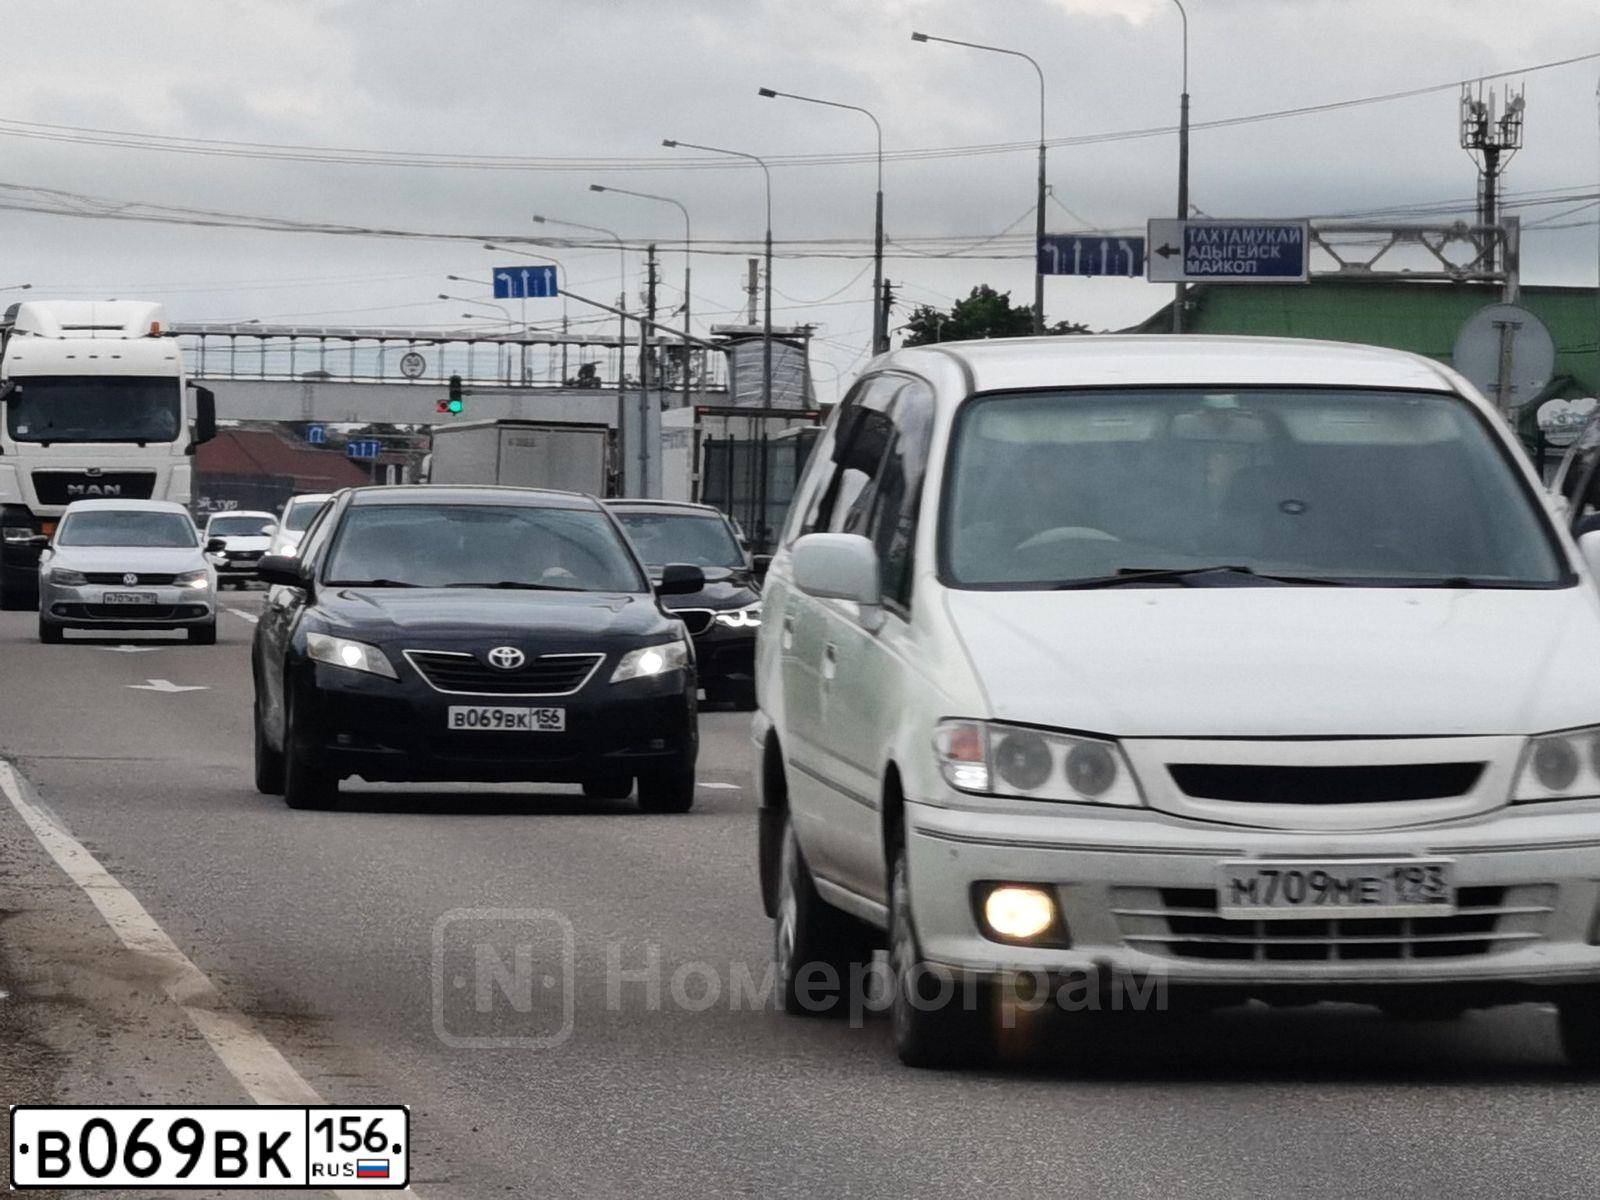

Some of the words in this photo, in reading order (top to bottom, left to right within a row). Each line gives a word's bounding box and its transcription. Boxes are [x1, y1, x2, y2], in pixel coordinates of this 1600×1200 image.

[1186, 260, 1257, 273] МАЙКОП
[67, 484, 121, 495] MAN
[454, 709, 528, 728] В069ВК
[532, 709, 560, 723] 156
[1231, 869, 1381, 905] М709МЕ
